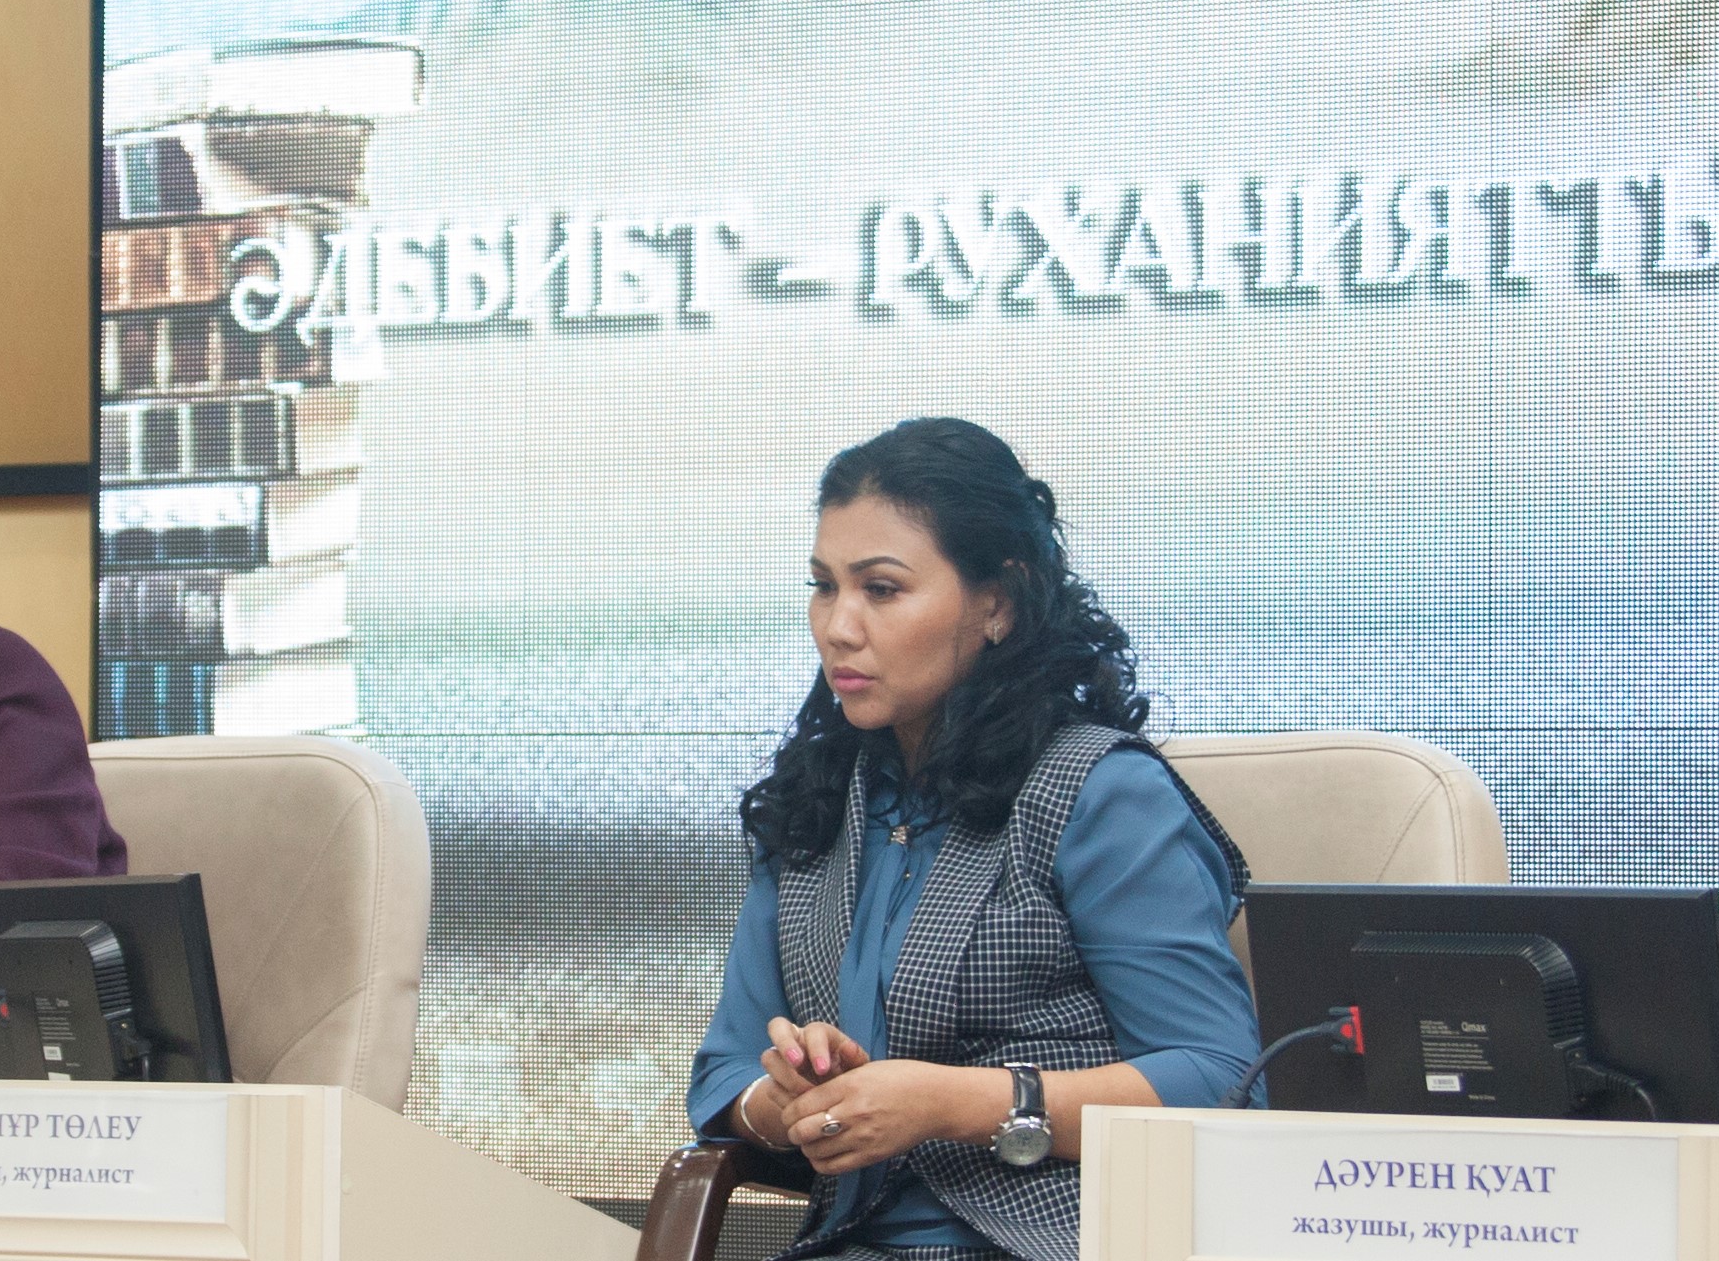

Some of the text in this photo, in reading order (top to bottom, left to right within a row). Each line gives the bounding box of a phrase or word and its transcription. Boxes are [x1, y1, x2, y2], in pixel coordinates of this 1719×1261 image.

[46, 1114, 142, 1141] ТӨЛЕУ
[12, 1165, 134, 1190] журналист
[1314, 1158, 1556, 1198] ДӘУРЕН ҚУАТ
[1292, 1215, 1579, 1248] жазушы, журналист
